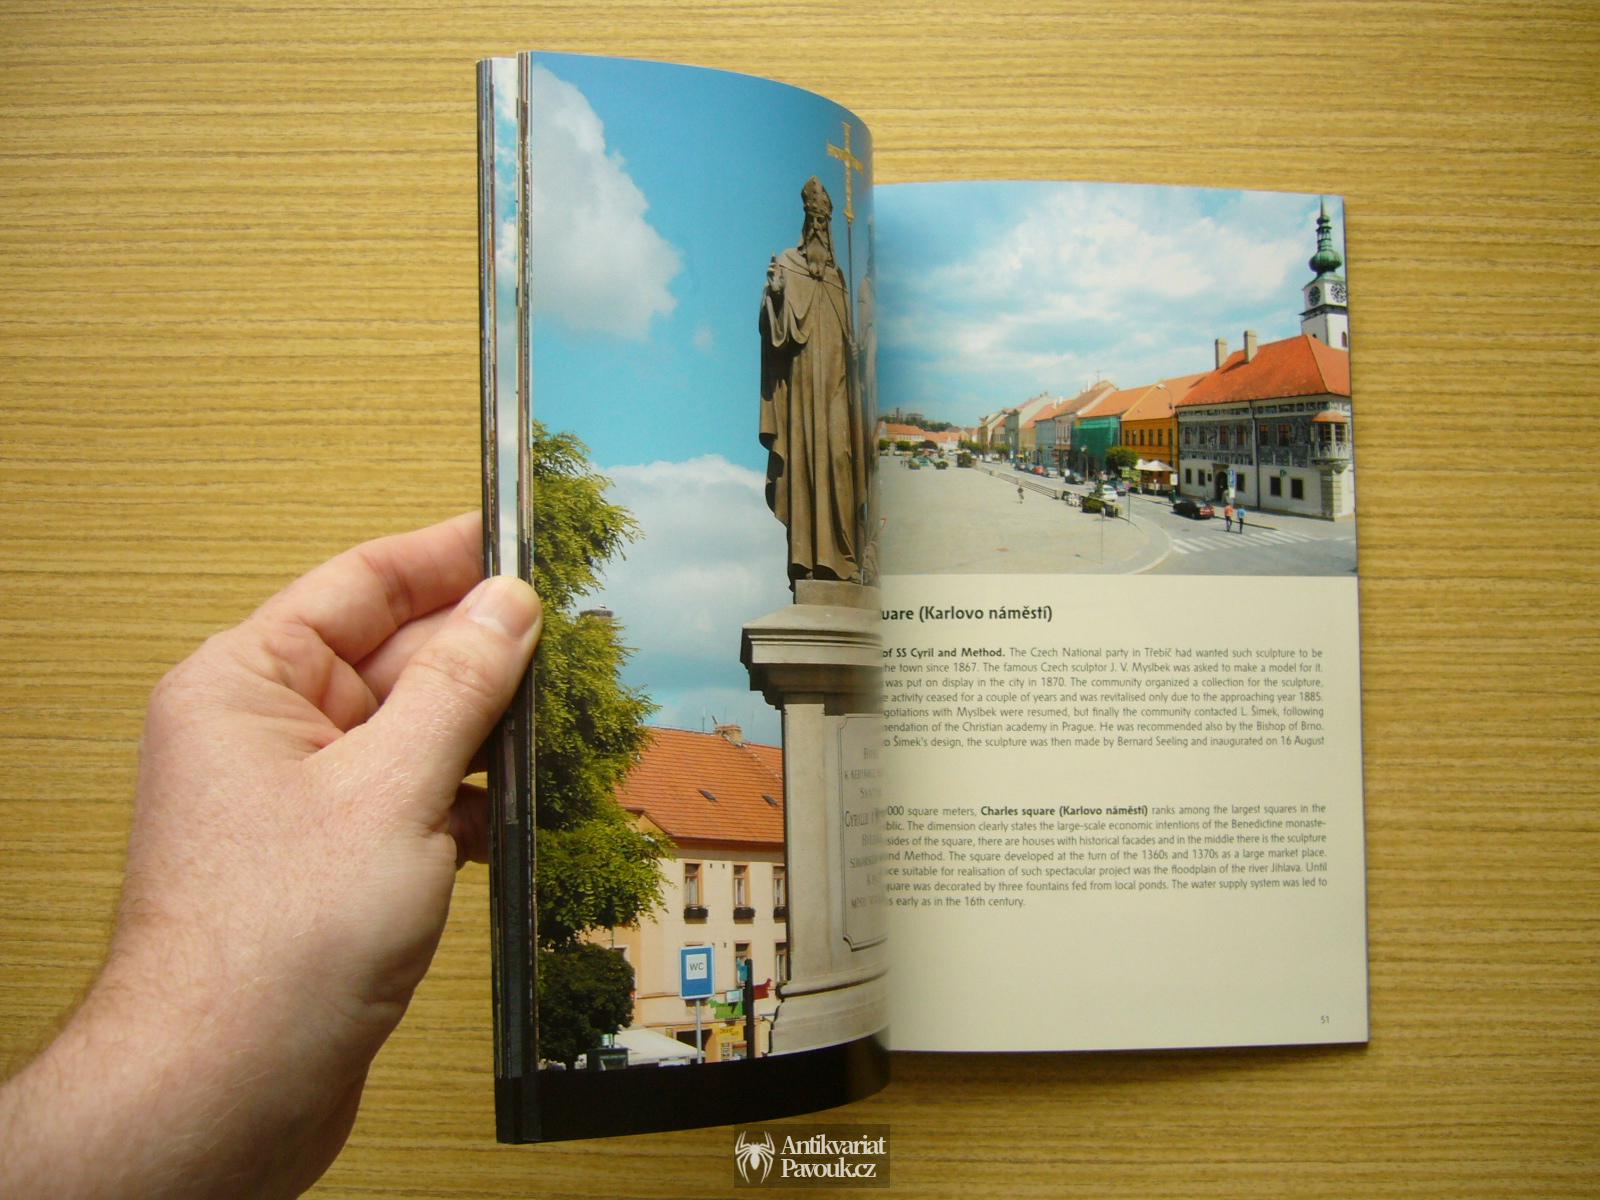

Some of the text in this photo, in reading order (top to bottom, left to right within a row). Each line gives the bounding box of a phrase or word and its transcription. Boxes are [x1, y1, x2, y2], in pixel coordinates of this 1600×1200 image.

[918, 606, 984, 624] (Karlovo
[988, 606, 1052, 624] náměstí)
[895, 648, 907, 657] SS
[909, 648, 934, 660] Cyril
[937, 648, 957, 657] and
[960, 648, 1005, 657] Method.
[1010, 648, 1026, 657] The
[1029, 648, 1058, 657] Czech
[1061, 648, 1102, 657] National
[1105, 648, 1128, 660] party
[1195, 648, 1228, 657] wanted
[1231, 648, 1252, 657] such
[1255, 648, 1295, 660] sculpture
[898, 664, 923, 672] town
[925, 662, 949, 672] since
[983, 662, 1000, 672] The
[1002, 662, 1037, 672] famous
[1040, 662, 1068, 672] Czech
[1071, 662, 1107, 675] sculptor
[1131, 662, 1170, 675] Myslbek
[1193, 662, 1219, 672] asked
[1233, 662, 1257, 672] make
[1268, 662, 1297, 672] model
[941, 678, 973, 690] display
[1008, 678, 1024, 690] city
[1070, 678, 1087, 687] The
[1090, 678, 1141, 690] community
[1145, 678, 1190, 690] organized
[1201, 678, 1244, 687] collection
[890, 692, 922, 704] activity
[925, 692, 958, 702] ceased
[960, 692, 974, 702] for
[985, 692, 1017, 704] couple
[1032, 694, 1057, 704] years
[1099, 692, 1146, 702] revitalised
[1148, 692, 1168, 704] only
[1170, 692, 1188, 702] due
[1219, 692, 1275, 704] approaching
[1276, 694, 1295, 704] year
[932, 707, 952, 717] with
[956, 707, 996, 719] Myslbek
[1073, 707, 1089, 717] but
[1091, 707, 1119, 719] finally
[1140, 707, 1191, 719] community
[1194, 707, 1237, 716] contacted
[1282, 706, 1324, 719] following
[961, 722, 1002, 732] Christian
[1006, 722, 1047, 734] academy
[1116, 724, 1134, 732] was
[1136, 722, 1202, 732] recommended
[1204, 722, 1223, 731] also
[1255, 721, 1285, 733] Bishop
[893, 736, 927, 747] Šimek's
[984, 737, 1027, 749] sculpture
[1050, 737, 1071, 747] then
[1074, 737, 1100, 747] made
[1116, 737, 1153, 747] Bernard
[1155, 736, 1188, 749] Seeling
[1209, 736, 1263, 748] inaugurated
[1293, 736, 1324, 748] August
[907, 808, 938, 818] square
[980, 806, 1018, 816] Charles
[1021, 808, 1055, 818] square
[1058, 806, 1102, 818] (Karlovo
[1151, 805, 1175, 815] ranks
[1178, 807, 1210, 817] among
[1230, 804, 1260, 816] largest
[1263, 806, 1297, 816] squares
[1311, 803, 1326, 813] the
[926, 821, 975, 831] dimension
[978, 821, 1008, 833] clearly
[1010, 822, 1037, 830] states
[1108, 820, 1153, 830] economic
[1155, 820, 1200, 830] intentions
[1213, 819, 1228, 829] the
[1230, 819, 1282, 829] Benedictine
[1285, 819, 1325, 828] monaste-
[887, 836, 909, 846] sides
[977, 836, 1002, 846] there
[1021, 836, 1054, 846] houses
[1056, 836, 1077, 845] with
[1078, 836, 1119, 845] historical
[1121, 835, 1155, 845] facades
[1157, 835, 1175, 845] and
[1203, 834, 1234, 844] middle
[1236, 834, 1260, 844] there
[1269, 834, 1285, 843] the
[1286, 833, 1326, 845] sculpture
[969, 853, 1000, 863] square
[1004, 851, 1054, 863] developed
[1087, 852, 1107, 860] turn
[1122, 850, 1138, 860] the
[1241, 849, 1264, 861] large
[1267, 848, 1298, 858] market
[901, 866, 937, 876] suitable
[956, 866, 1005, 876] realisation
[1020, 866, 1042, 876] such
[1045, 866, 1095, 878] spectacular
[1098, 865, 1131, 878] project
[1170, 864, 1216, 876] floodplain
[1247, 863, 1268, 873] river
[1305, 863, 1327, 872] Until
[912, 883, 931, 891] was
[933, 881, 981, 891] decorated
[997, 881, 1022, 890] three
[1025, 881, 1069, 890] fountains
[1089, 880, 1112, 890] from
[1114, 880, 1136, 890] local
[1190, 880, 1215, 889] water
[1218, 879, 1247, 891] supply
[1250, 879, 1280, 890] system
[1282, 880, 1299, 888] was
[895, 896, 918, 908] early
[964, 895, 985, 904] 16th
[689, 962, 705, 971] WC
[1320, 1015, 1330, 1025] 51
